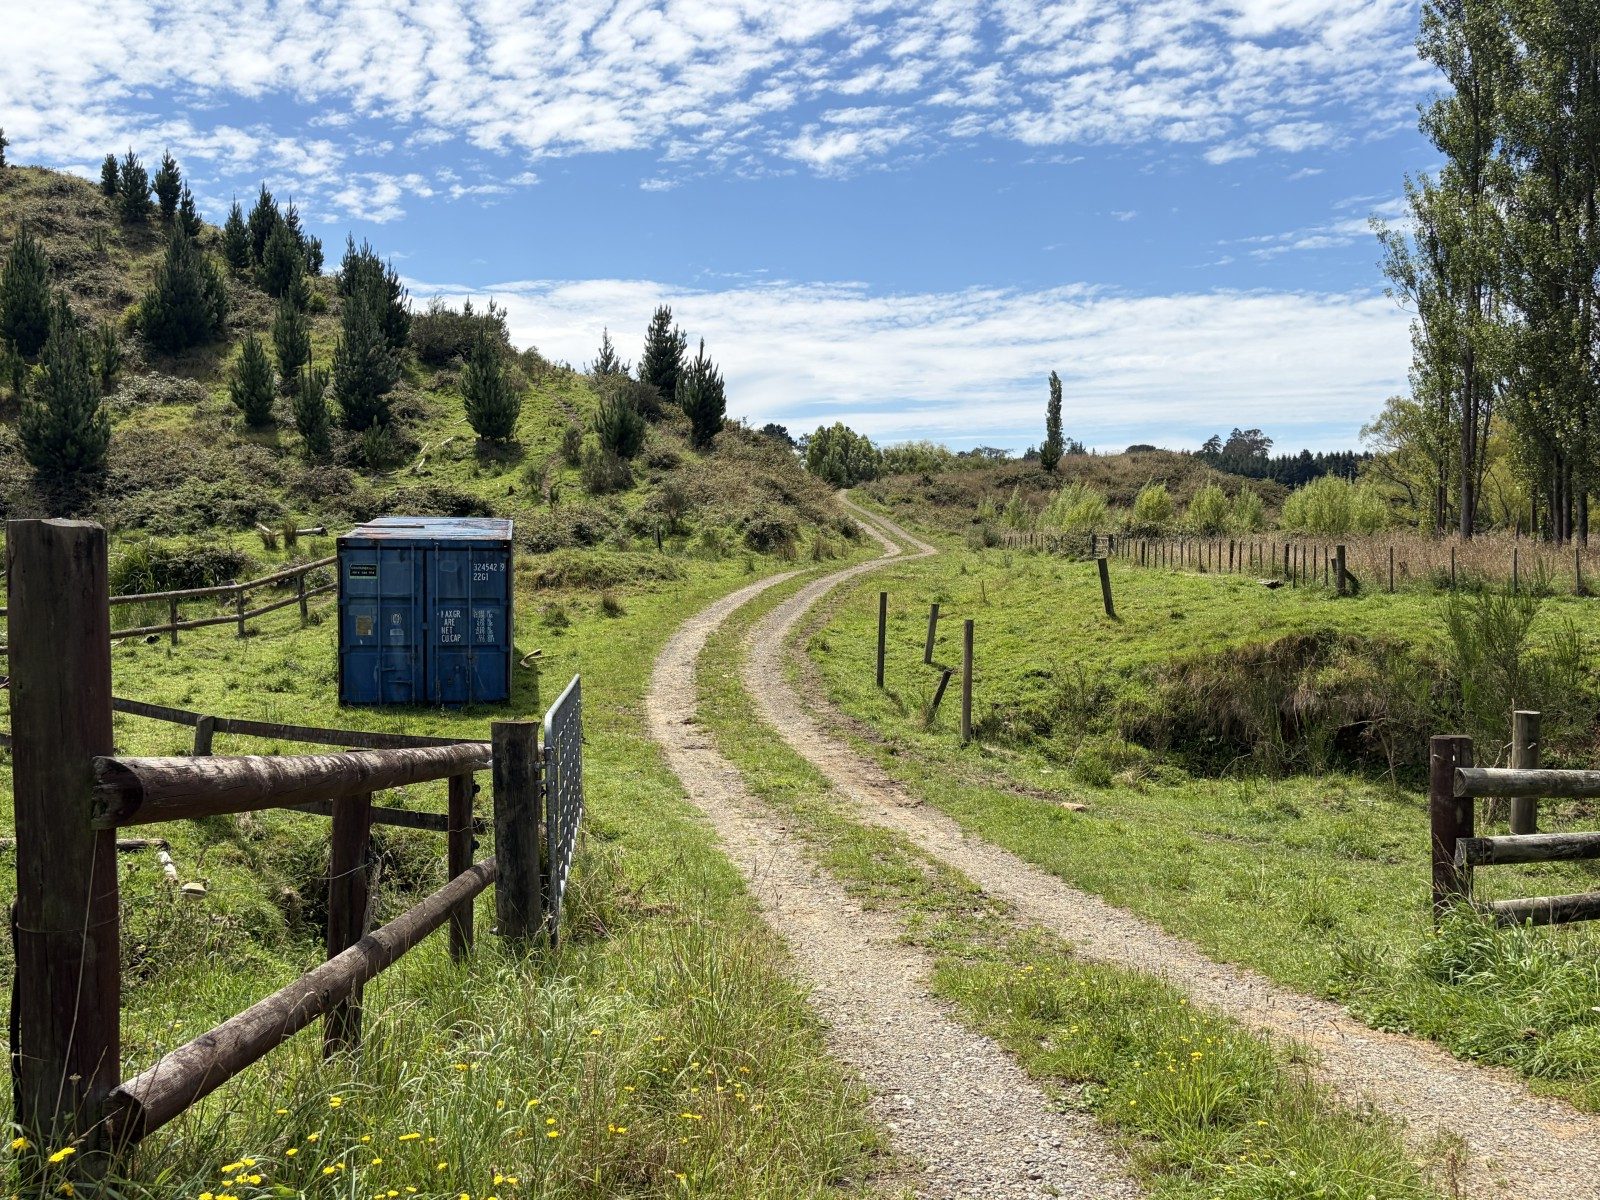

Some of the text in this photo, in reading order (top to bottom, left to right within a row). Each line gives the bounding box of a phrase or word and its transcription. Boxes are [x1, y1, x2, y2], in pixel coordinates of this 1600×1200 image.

[473, 563, 498, 572] 324542
[473, 572, 489, 581] 22G1
[441, 626, 453, 635] NET
